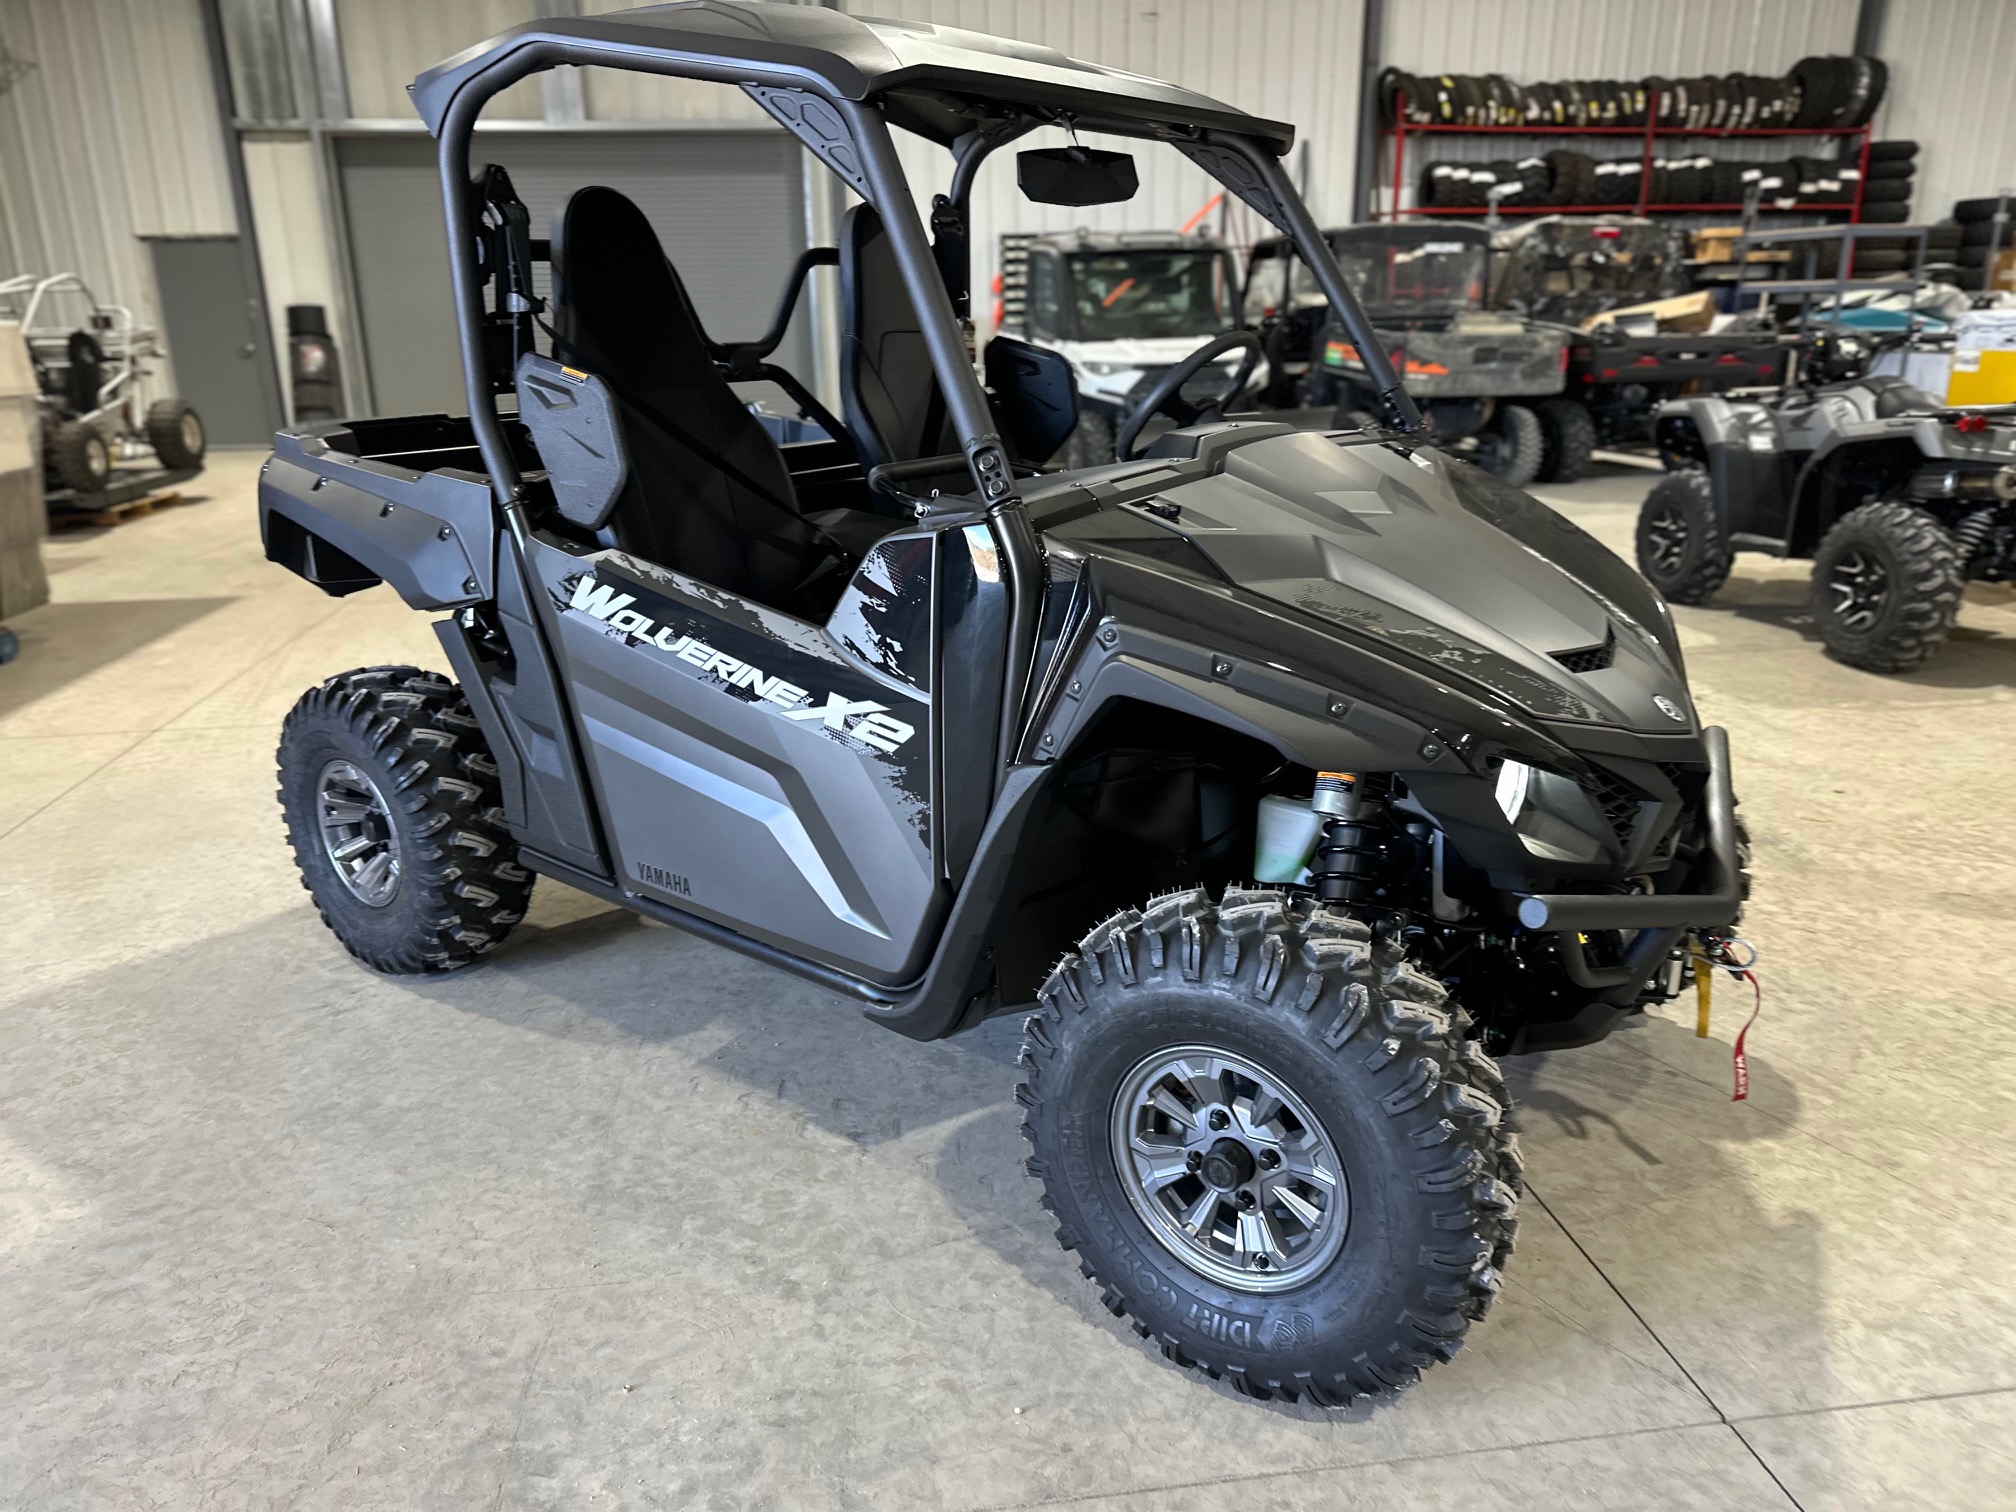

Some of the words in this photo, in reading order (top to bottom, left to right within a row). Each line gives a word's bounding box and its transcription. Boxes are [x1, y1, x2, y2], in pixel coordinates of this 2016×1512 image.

[569, 575, 810, 709] WOLVERINE
[778, 691, 915, 752] X2
[637, 862, 691, 896] YAMAHA
[1062, 1112, 1180, 1312] COMMANDER
[1183, 1303, 1252, 1348] DIRT
